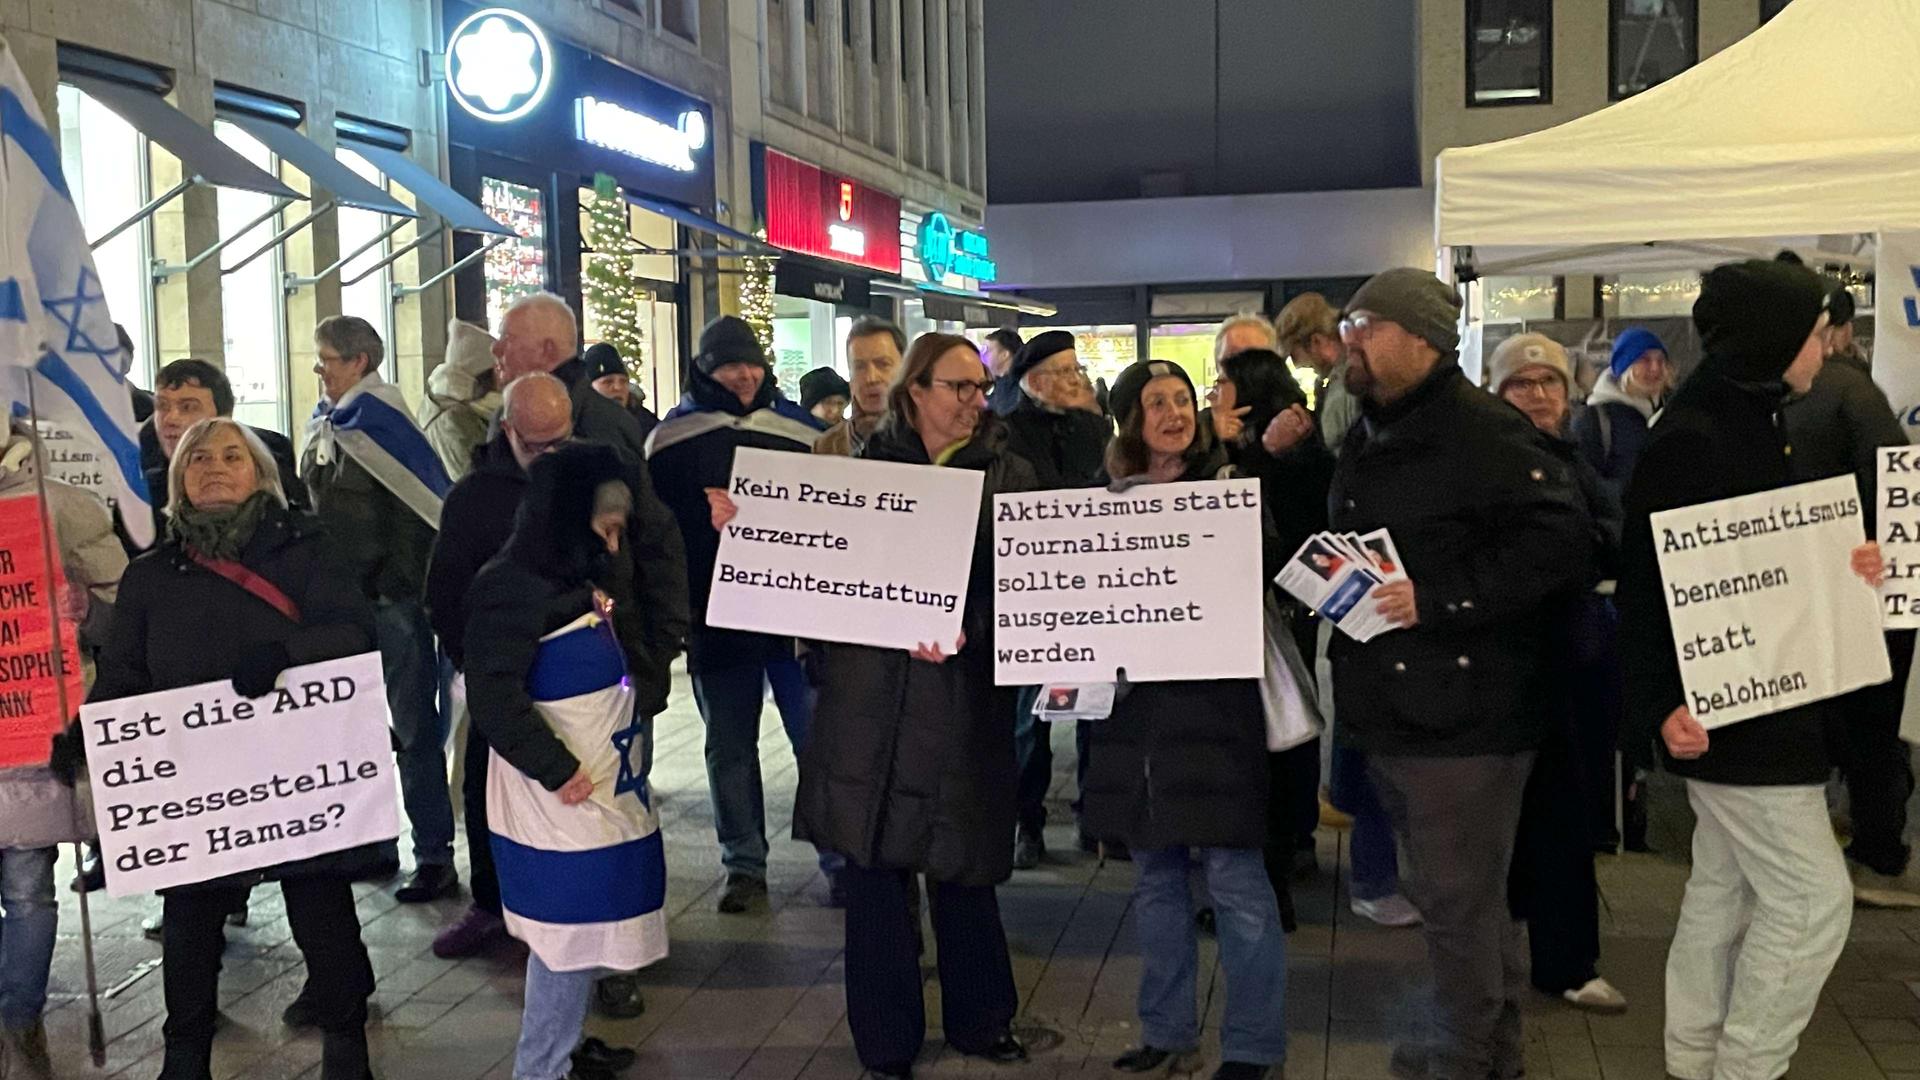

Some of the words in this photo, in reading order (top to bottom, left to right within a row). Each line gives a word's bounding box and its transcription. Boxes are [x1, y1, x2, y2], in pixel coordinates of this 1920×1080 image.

[732, 476, 790, 501] Kein
[798, 483, 867, 508] Preis
[874, 492, 918, 513] für
[997, 498, 1164, 522] Aktivismus
[1173, 488, 1258, 512] statt
[727, 525, 849, 550] verzerrte
[1663, 497, 1859, 553] Antisemitismus
[1886, 522, 1920, 543] A
[997, 532, 1190, 557] Journalismus
[0, 550, 15, 575] R
[998, 571, 1086, 593] sollte
[1097, 566, 1178, 590] nicht
[718, 563, 959, 613] Berichterstattung
[1670, 565, 1789, 607] benennen
[998, 602, 1203, 632] ausgezeichnet
[997, 642, 1095, 663] werden
[1683, 621, 1756, 661] statt
[0, 650, 72, 683] SOPHE
[1691, 671, 1808, 715] belohnen
[95, 710, 166, 746] Ist
[182, 702, 256, 729] die
[272, 675, 357, 714] ARD
[102, 759, 178, 788] die
[107, 759, 379, 832] Pressestelle
[115, 842, 190, 872] der
[206, 803, 347, 855] Hamas?
